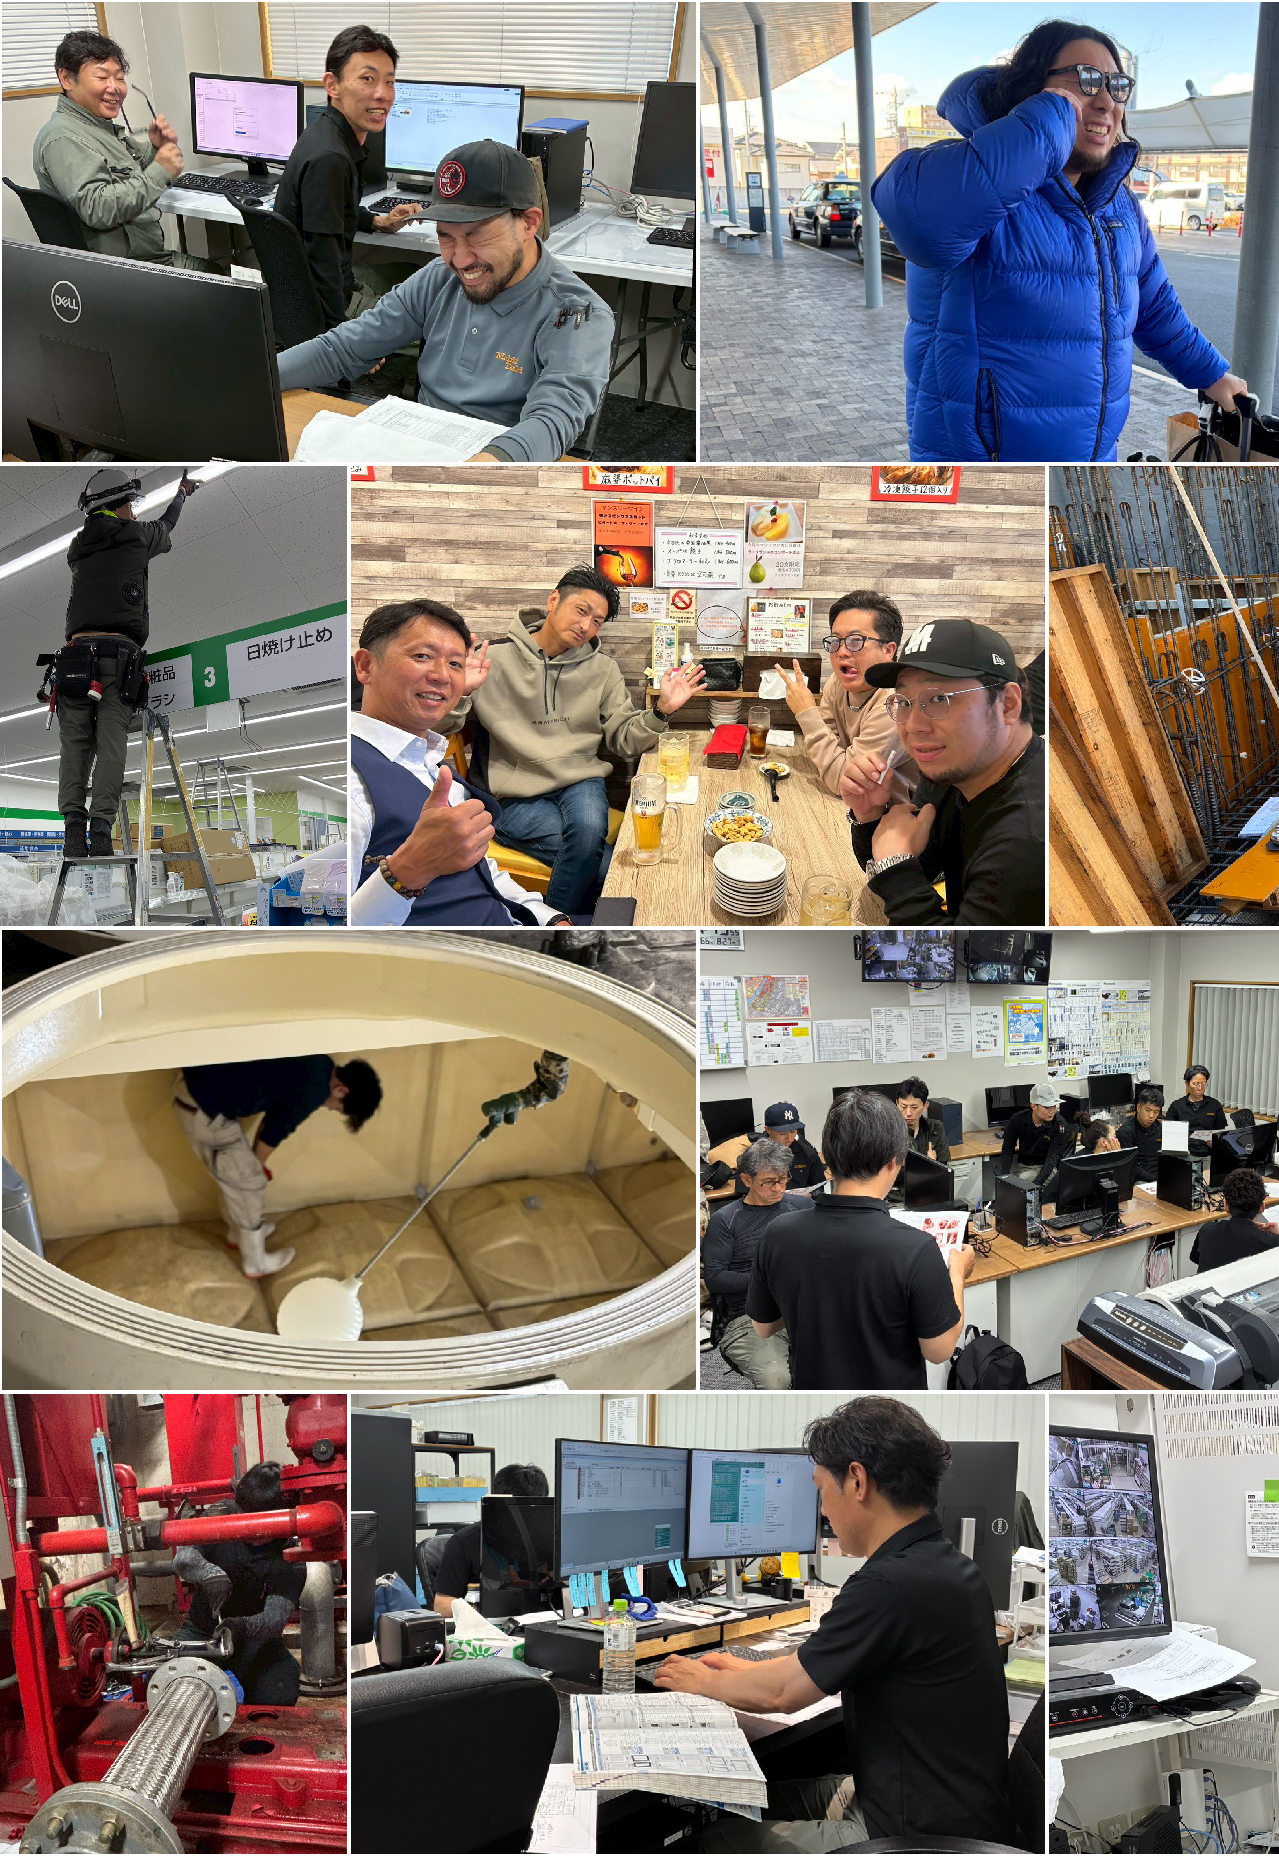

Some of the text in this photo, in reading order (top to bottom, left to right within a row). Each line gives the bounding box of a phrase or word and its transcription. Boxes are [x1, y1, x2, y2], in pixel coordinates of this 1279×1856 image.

[54, 294, 79, 310] DELL
[247, 626, 334, 661] 日焼け止め
[204, 666, 216, 688] 3
